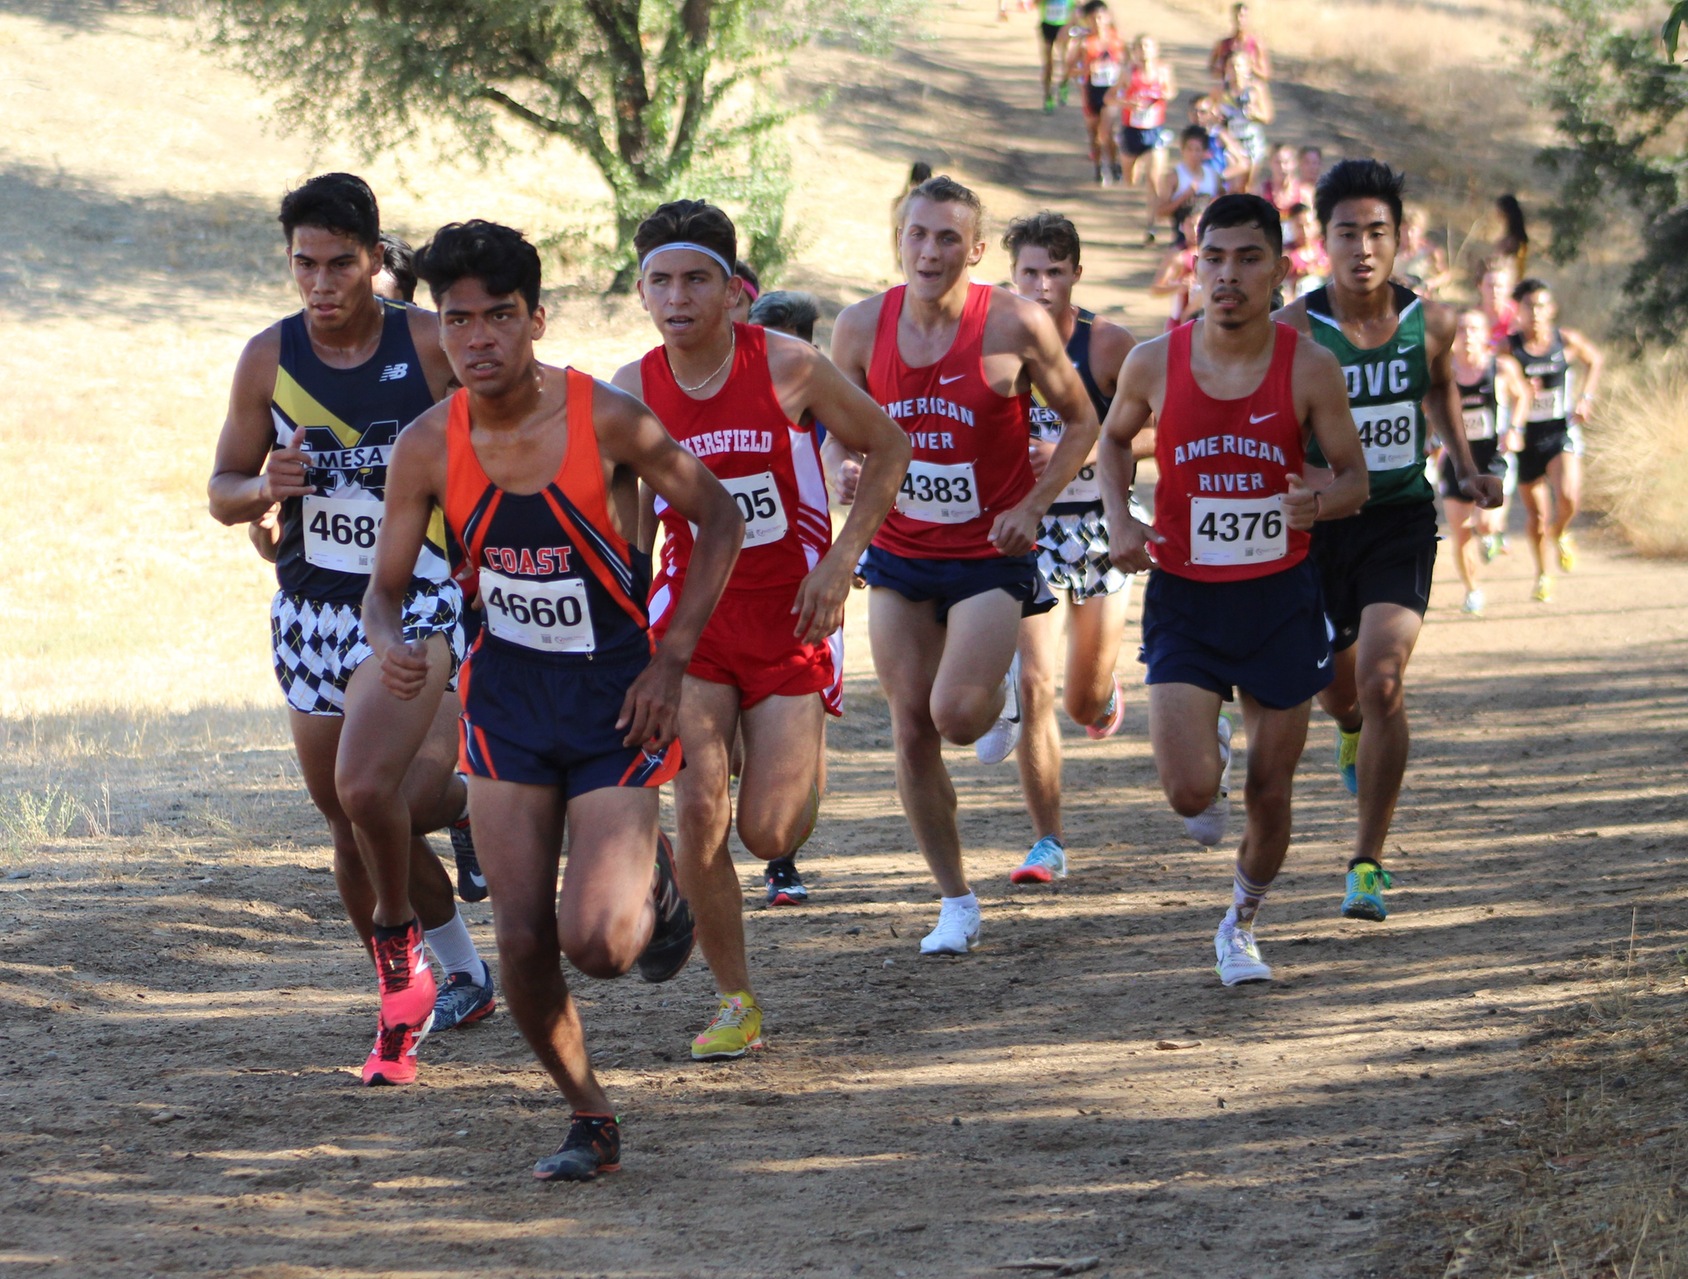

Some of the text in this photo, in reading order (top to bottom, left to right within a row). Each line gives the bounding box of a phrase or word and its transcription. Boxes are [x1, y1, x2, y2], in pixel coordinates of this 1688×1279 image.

[1340, 359, 1409, 399] DVC
[880, 397, 975, 428] MERICAN
[679, 429, 773, 459] KERSFIELD
[907, 432, 955, 450] IVER
[1358, 415, 1411, 449] 488
[317, 446, 385, 469] MESA
[1174, 434, 1287, 466] AMERICAN
[900, 472, 972, 504] 4383
[1197, 472, 1265, 492] RIVER
[309, 510, 384, 549] 468
[1196, 509, 1283, 542] 4376
[483, 545, 572, 576] COAST
[487, 586, 583, 628] 4660
